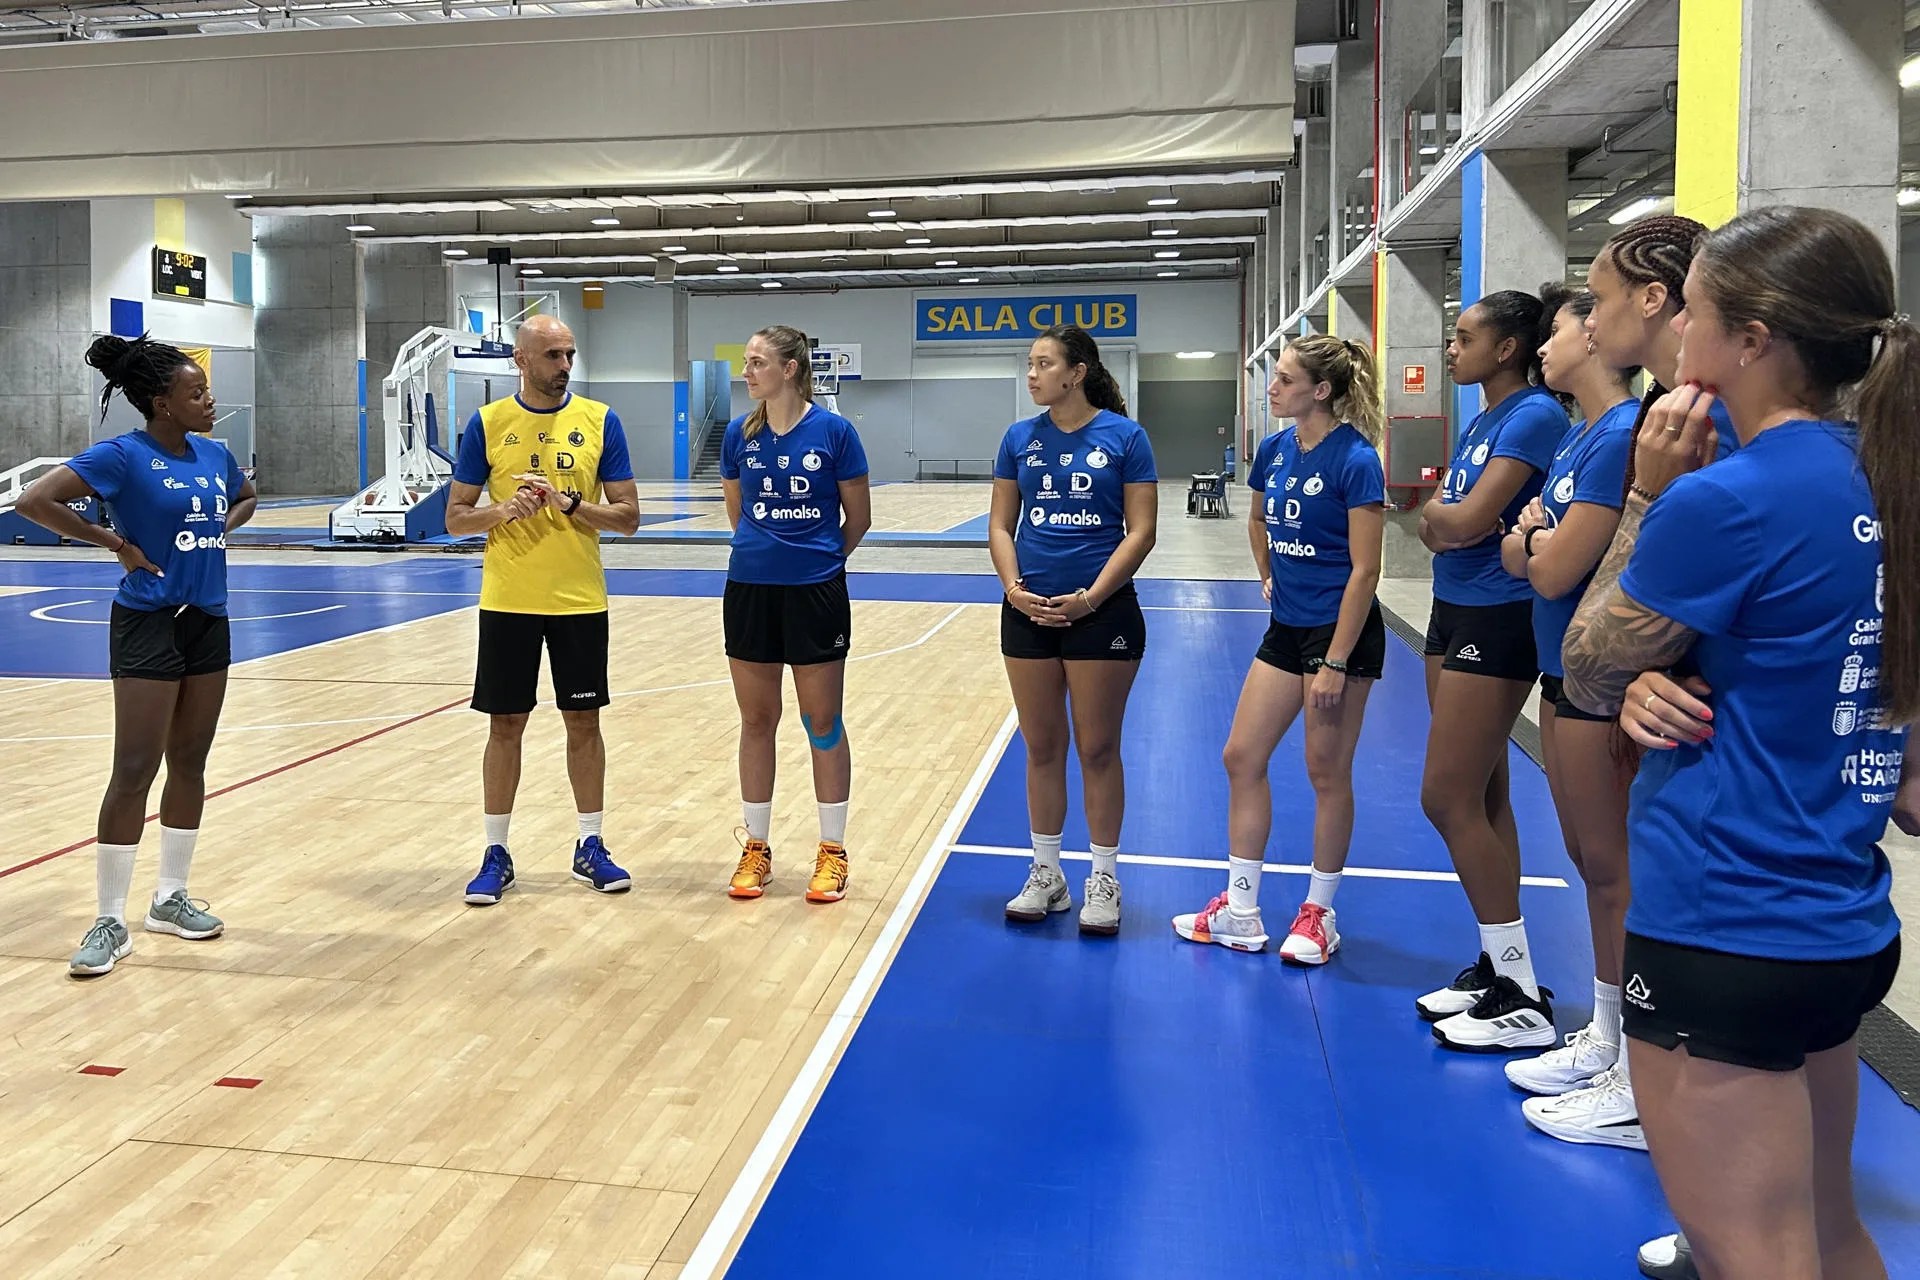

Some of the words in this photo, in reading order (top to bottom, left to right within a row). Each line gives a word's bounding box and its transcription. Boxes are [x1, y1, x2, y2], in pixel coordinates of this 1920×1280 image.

[176, 253, 194, 268] 9:02
[927, 305, 1019, 332] SALA
[1028, 302, 1127, 330] CLUB
[771, 504, 821, 519] emalsa
[1049, 509, 1101, 525] emalsa
[1855, 618, 1883, 632] Cabil
